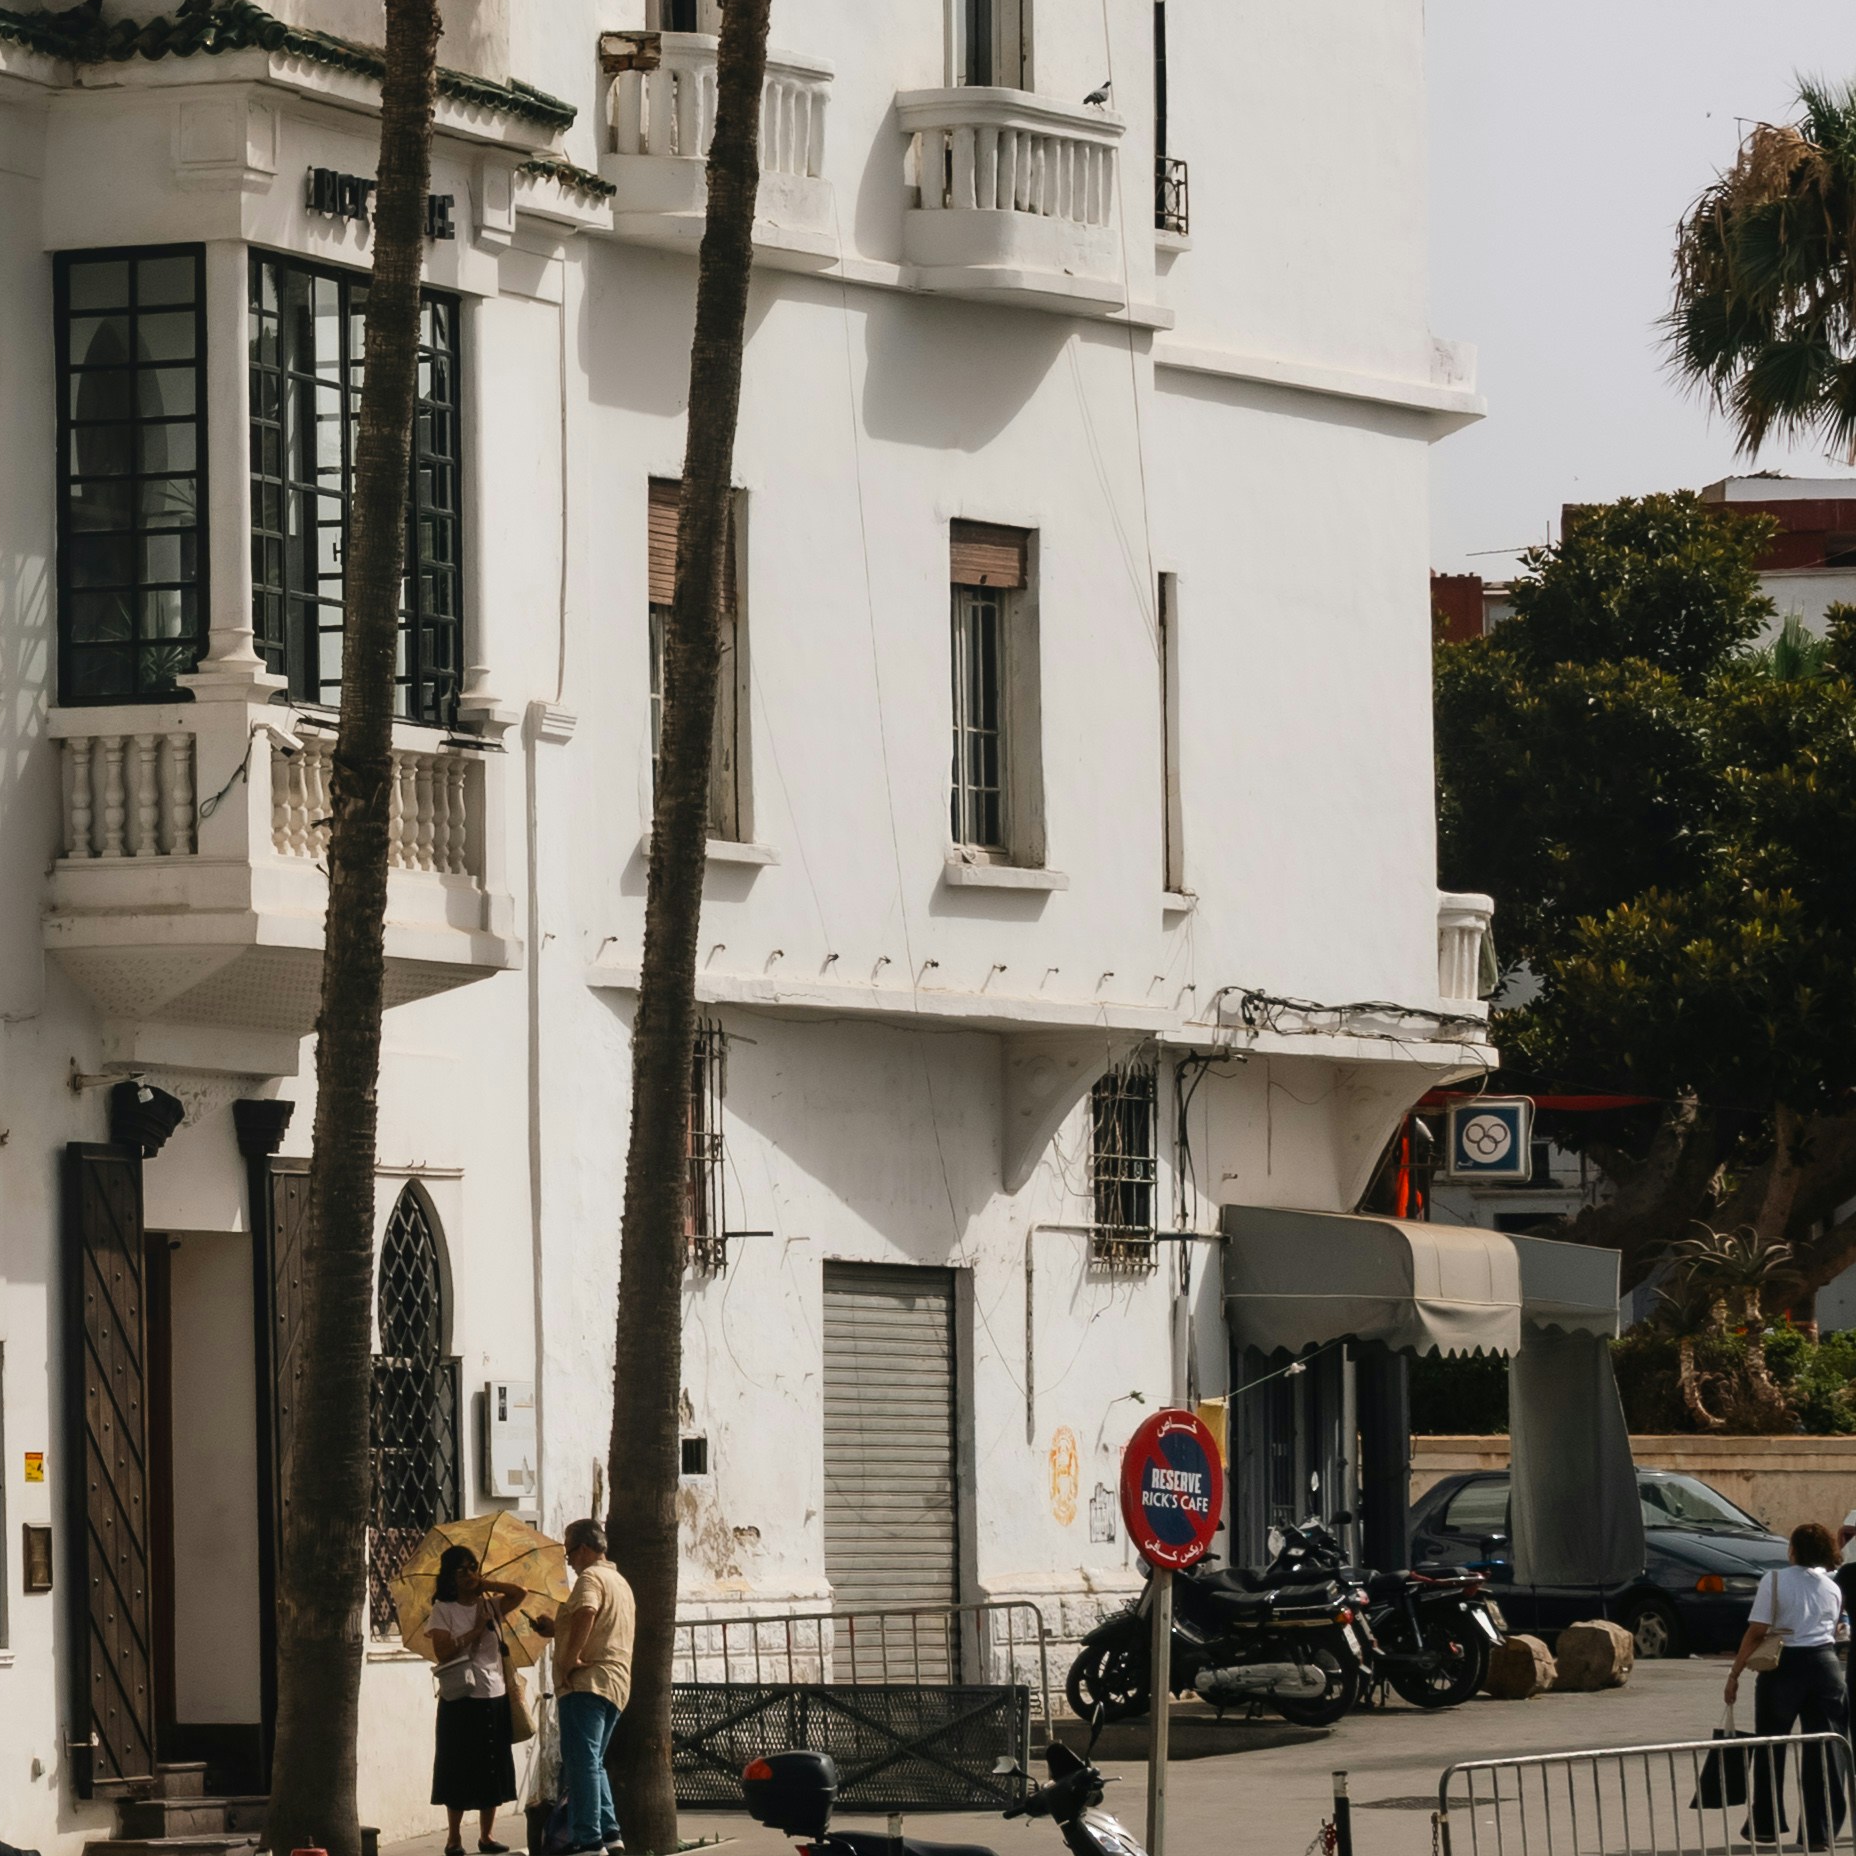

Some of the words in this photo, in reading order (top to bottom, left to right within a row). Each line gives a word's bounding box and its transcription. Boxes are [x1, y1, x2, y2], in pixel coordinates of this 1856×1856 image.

[1151, 1468, 1202, 1494] RESERVE
[1142, 1490, 1178, 1509] RICK'S
[1180, 1495, 1209, 1513] CAFE
